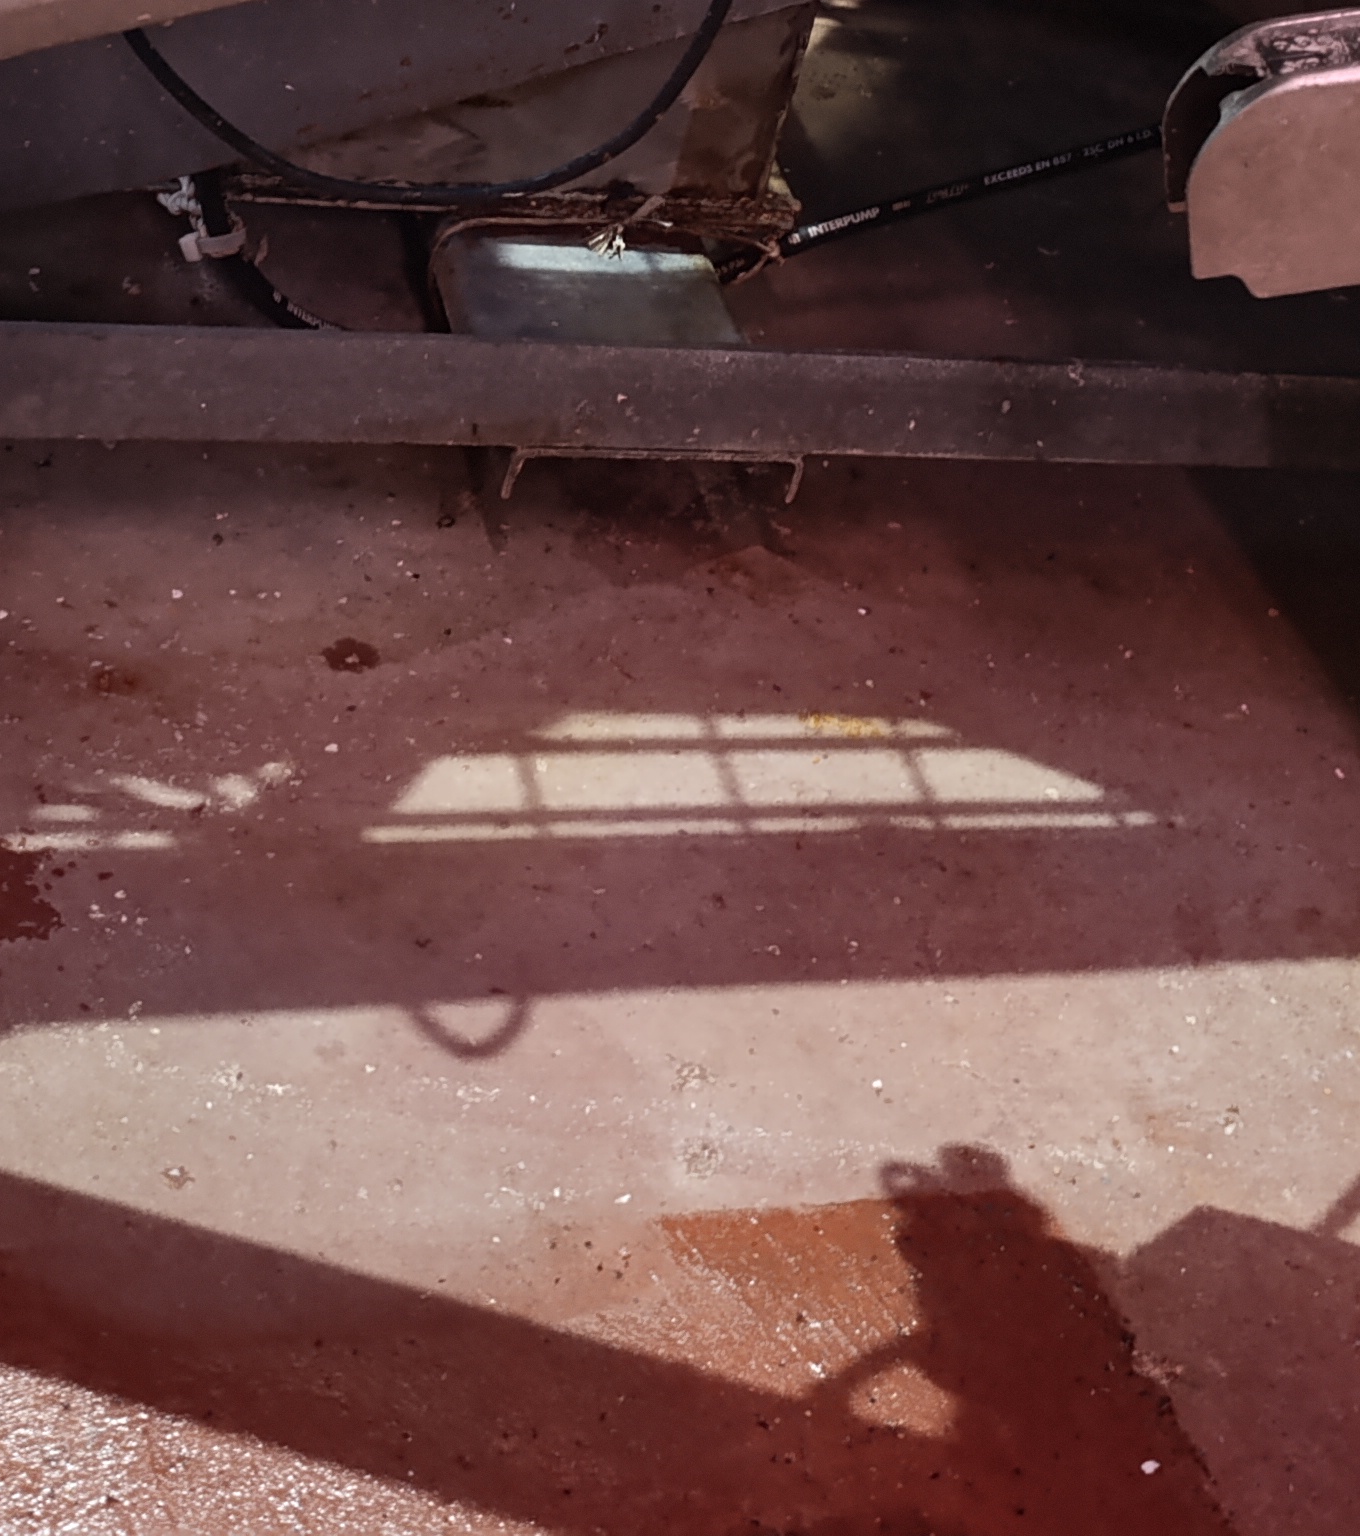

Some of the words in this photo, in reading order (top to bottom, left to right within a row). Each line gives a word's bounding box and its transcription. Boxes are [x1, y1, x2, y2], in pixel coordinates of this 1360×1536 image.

[807, 207, 880, 238] INTERPUMP
[983, 164, 1033, 186] EXCEEDS
[1035, 160, 1051, 172] EN
[1107, 138, 1125, 150] DN
